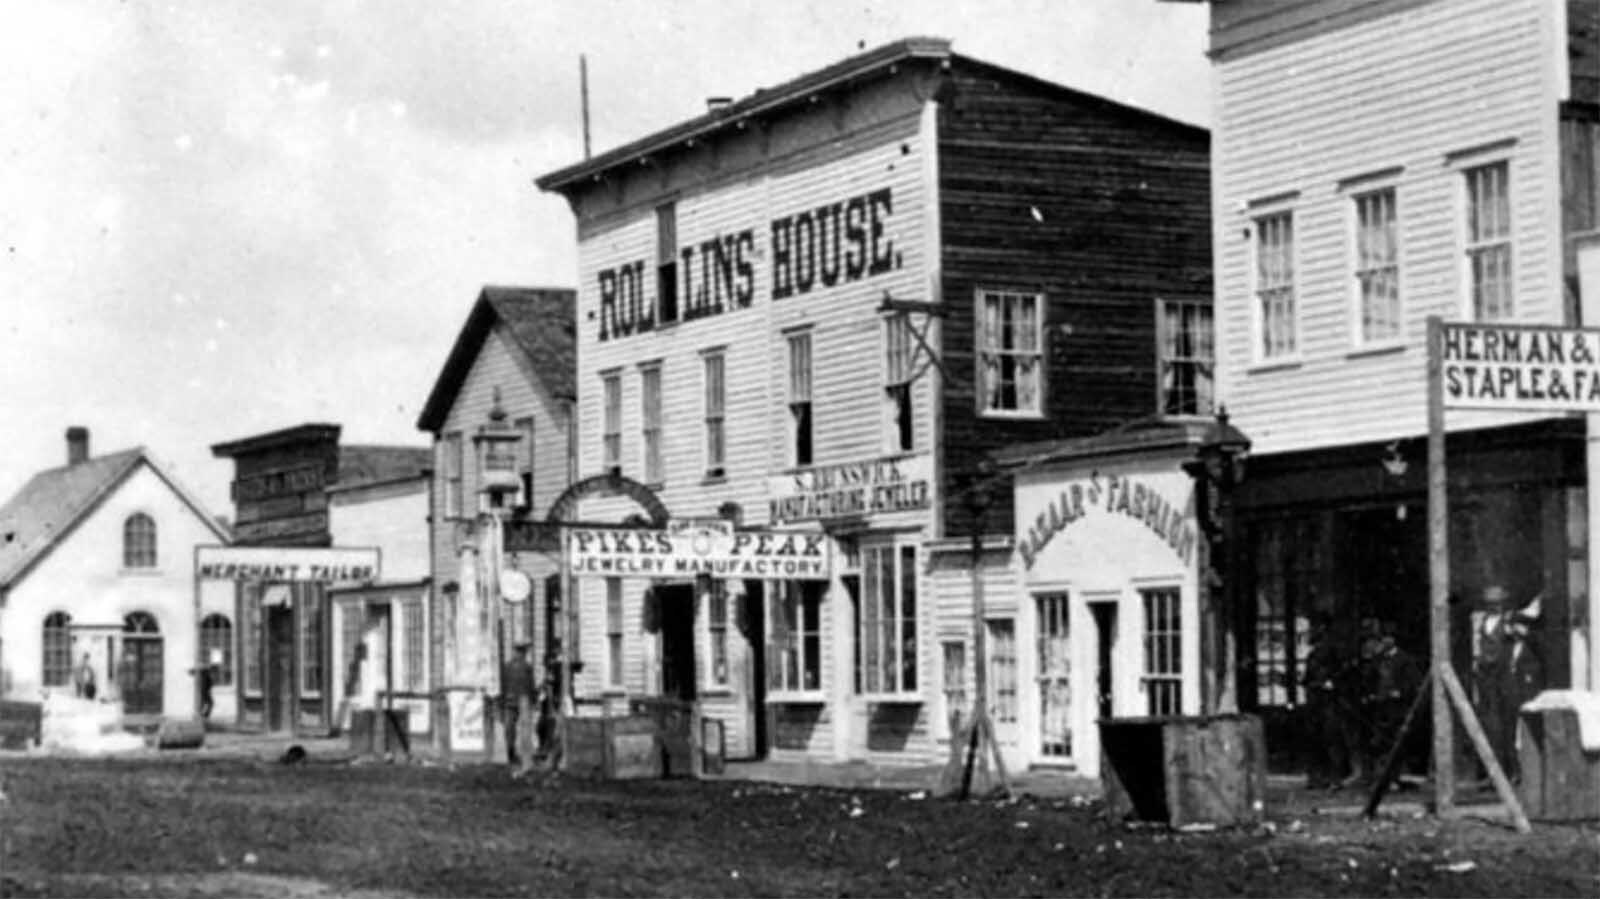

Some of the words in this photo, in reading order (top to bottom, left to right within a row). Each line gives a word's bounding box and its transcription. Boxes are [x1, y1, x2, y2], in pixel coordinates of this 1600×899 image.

[771, 187, 903, 300] HOUSE.
[1443, 328, 1565, 363] HERMAN
[574, 531, 673, 553] PIKES
[730, 534, 823, 555] PEAK
[201, 563, 299, 580] MERCHANT
[310, 564, 373, 580] TAILOR
[573, 557, 664, 572] JEWELRY
